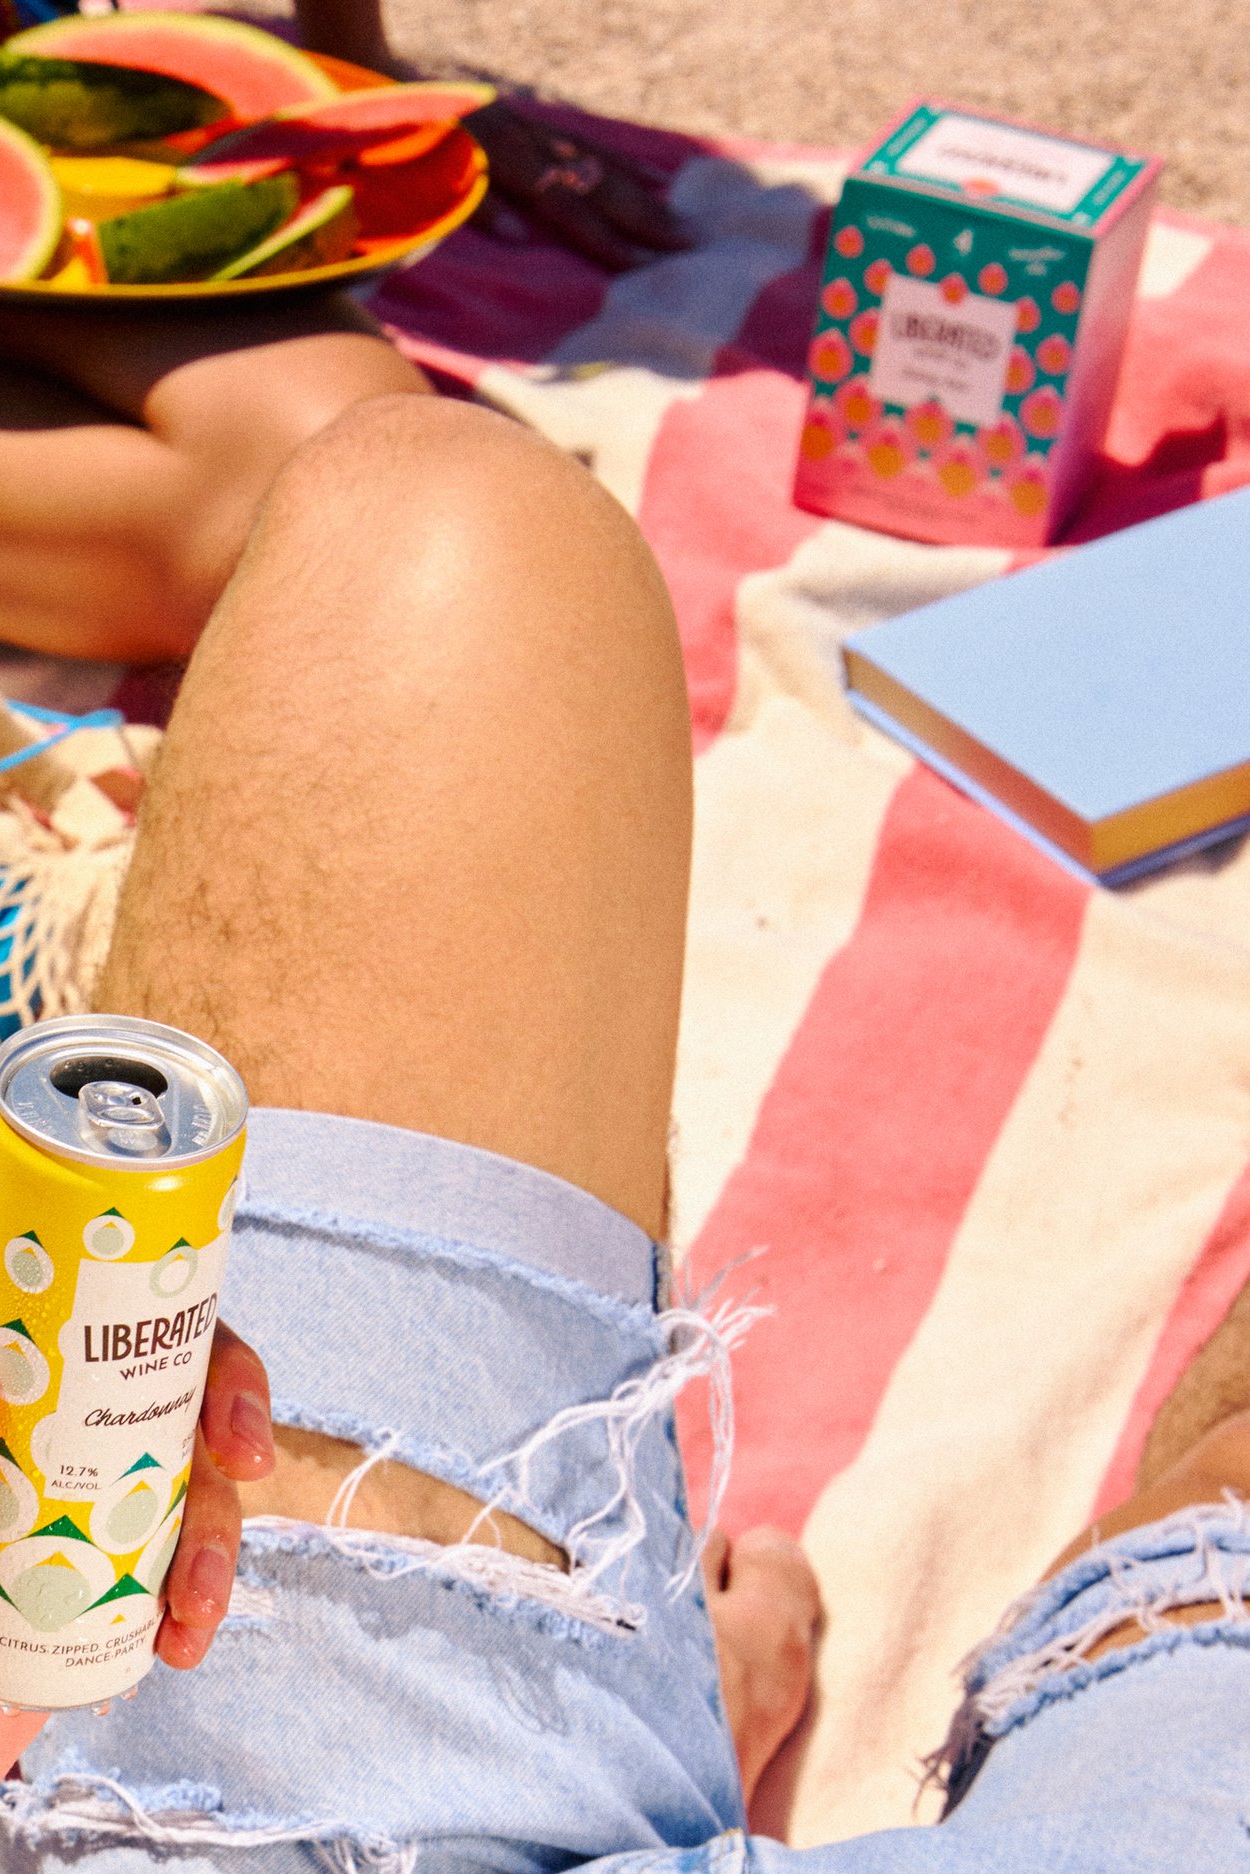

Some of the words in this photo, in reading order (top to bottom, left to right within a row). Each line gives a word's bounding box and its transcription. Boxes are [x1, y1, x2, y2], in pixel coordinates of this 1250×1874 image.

[84, 1292, 218, 1363] LIBERATED
[120, 1356, 169, 1381] WINE
[173, 1351, 193, 1367] CO
[84, 1385, 197, 1427] Chardonnay
[51, 1479, 101, 1490] ALC/VOL
[60, 1465, 99, 1477] 12.7%
